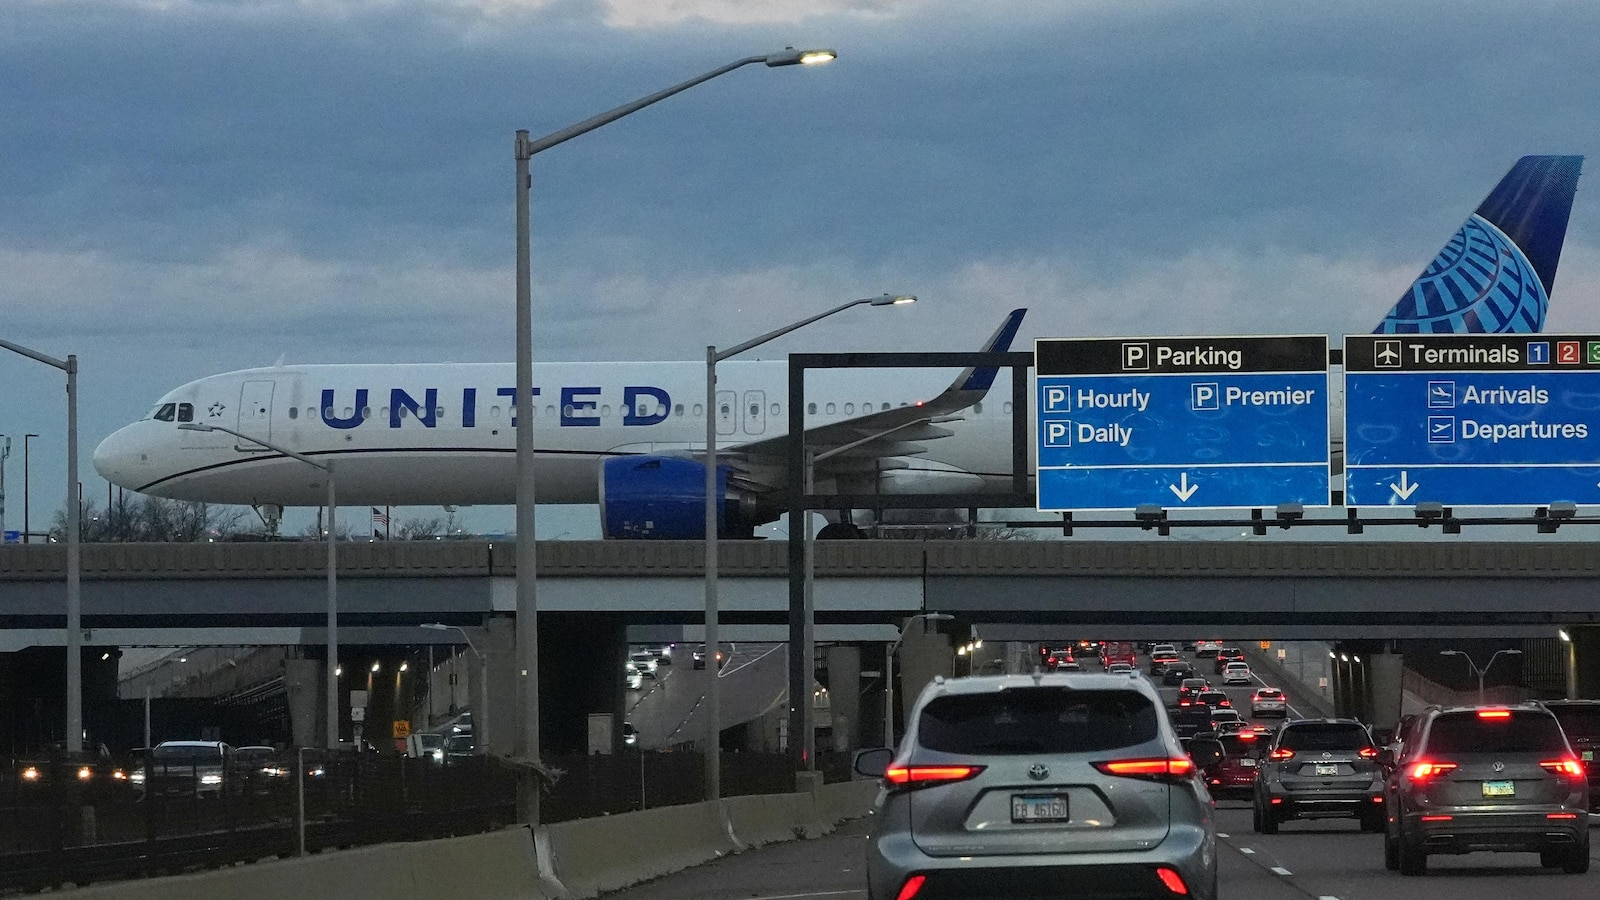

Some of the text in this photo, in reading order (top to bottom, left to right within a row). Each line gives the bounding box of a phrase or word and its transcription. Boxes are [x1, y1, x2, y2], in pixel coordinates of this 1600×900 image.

[1156, 347, 1243, 371] Parking
[1409, 344, 1519, 364] Terminals
[1533, 345, 1541, 361] 1
[1562, 344, 1575, 361] 2
[321, 386, 671, 428] UNITED
[1077, 388, 1150, 411] Hourly
[1226, 386, 1314, 406] Premier
[1463, 386, 1548, 405] Arrivals
[1078, 423, 1133, 446] Daily
[1462, 418, 1588, 442] Departures
